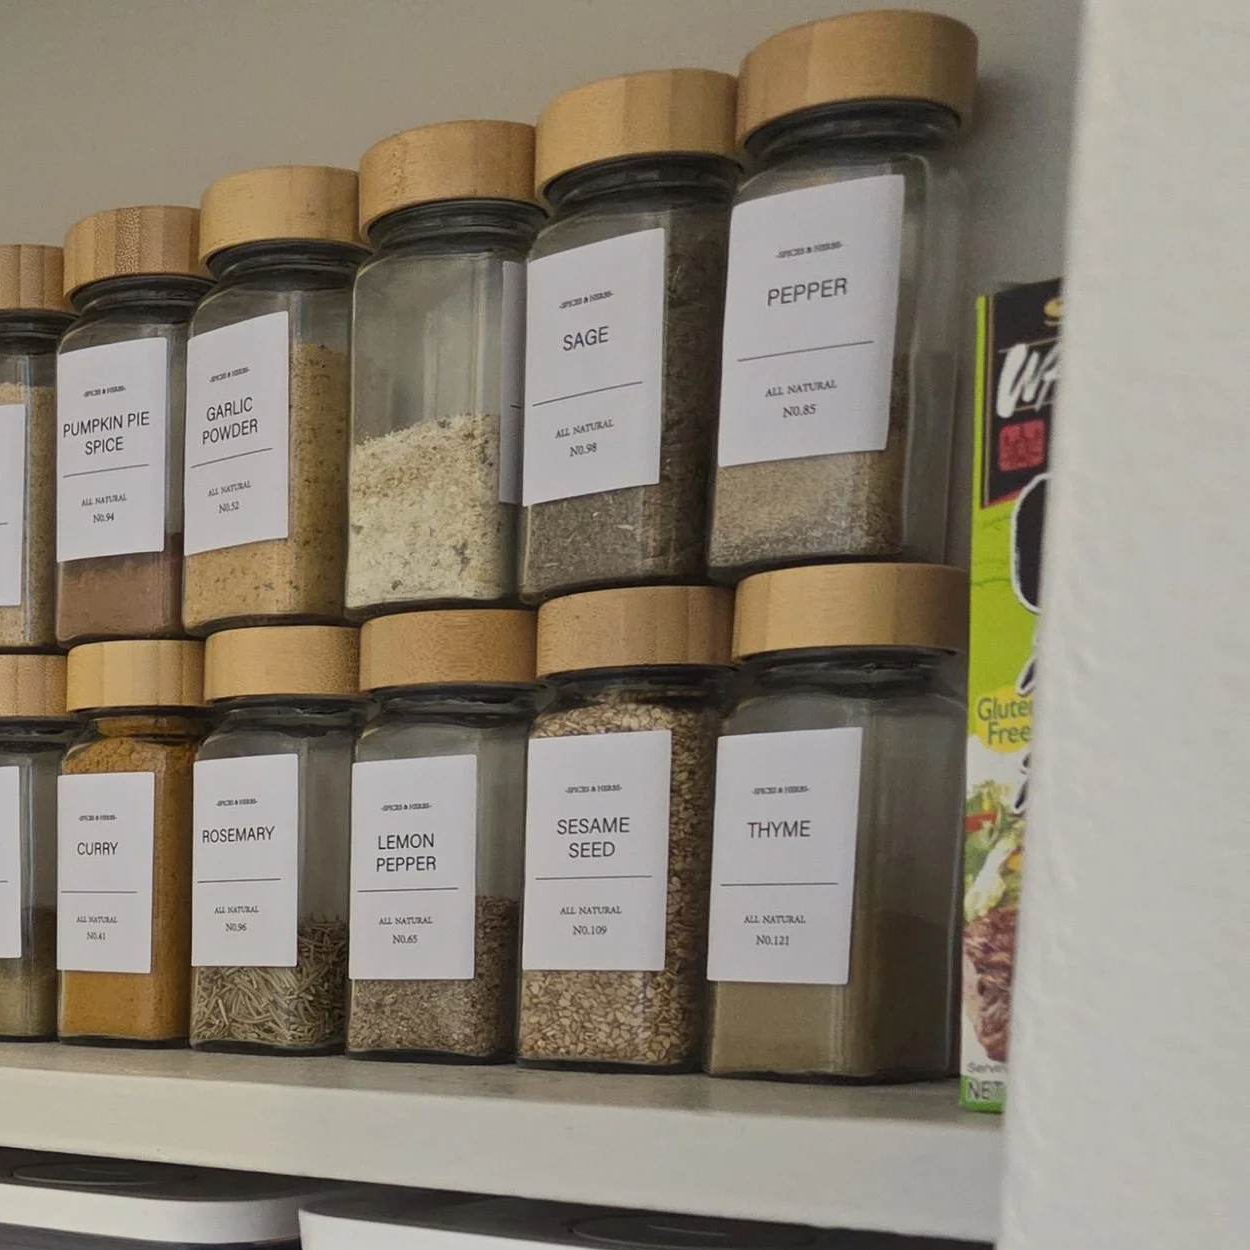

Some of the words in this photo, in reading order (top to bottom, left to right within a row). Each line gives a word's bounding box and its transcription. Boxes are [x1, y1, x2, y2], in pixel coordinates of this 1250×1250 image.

[767, 277, 848, 306] PEPPER
[562, 326, 610, 352] SAGE
[765, 386, 785, 398] ALL
[787, 380, 838, 395] NATURAL
[206, 397, 253, 422] GARLIC
[62, 414, 123, 438] PUMPKIN
[128, 411, 150, 428] PIE
[202, 419, 258, 445] POWDER
[555, 429, 571, 439] ALL
[573, 419, 614, 436] NATURAL
[84, 437, 124, 456] SPICE
[202, 826, 275, 843] ROSEMARY
[556, 817, 630, 835] SESAME
[747, 820, 811, 838] THYME
[77, 842, 118, 856] CURRY
[377, 833, 435, 850] LEMON
[568, 841, 616, 859] SEED
[376, 856, 436, 873] PEPPER
[560, 906, 577, 915] ALL
[579, 905, 622, 915] NATURAL
[378, 917, 392, 925] ALL
[394, 916, 433, 925] NATURAL
[744, 915, 760, 925] ALL
[762, 914, 806, 924] NATURAL
